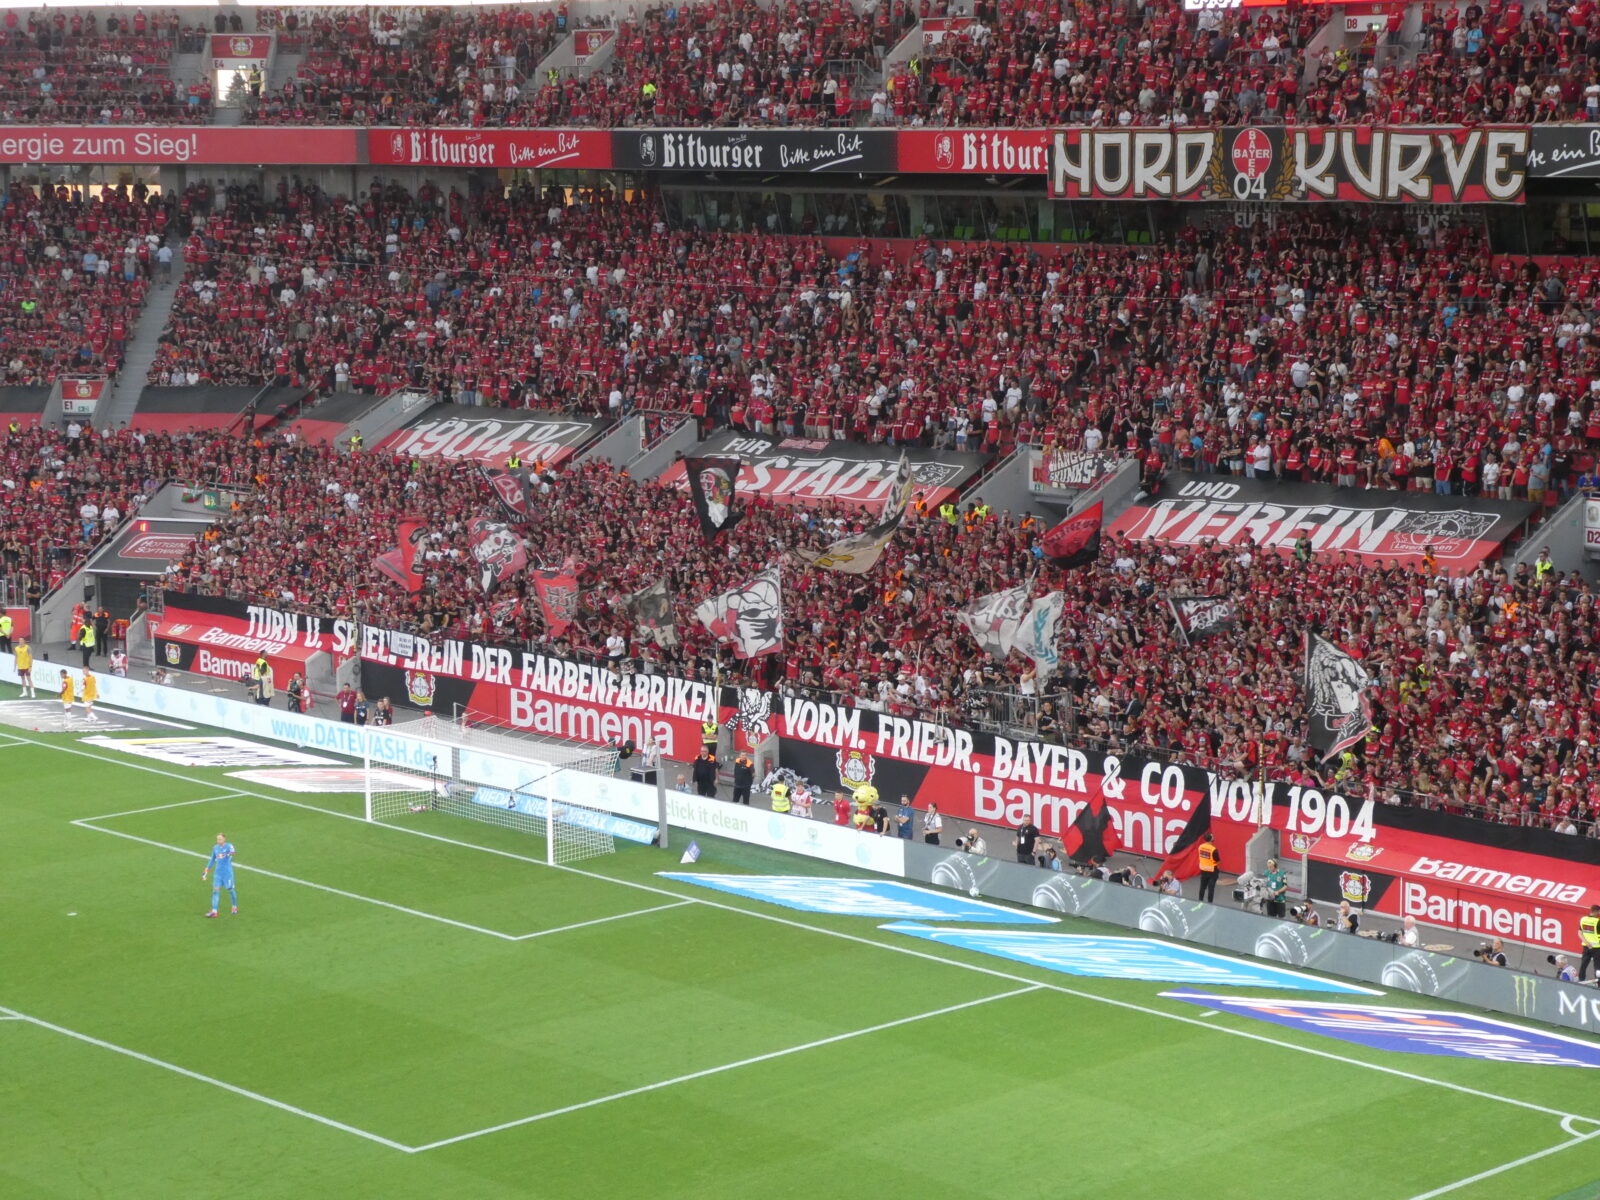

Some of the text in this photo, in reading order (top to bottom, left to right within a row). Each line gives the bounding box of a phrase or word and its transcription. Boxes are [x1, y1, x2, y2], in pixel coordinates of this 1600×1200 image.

[1346, 19, 1358, 30] D8
[213, 58, 225, 69] E4
[72, 137, 126, 156] zum
[134, 132, 198, 161] Sieg!
[410, 131, 496, 165] Bitburger
[509, 132, 581, 165] Bitte ein Bit
[662, 132, 764, 169] Bitburger
[780, 143, 811, 168] Bitte
[812, 144, 836, 159] ein
[961, 132, 1049, 171] Bitbur
[1233, 148, 1270, 159] BAYER
[1551, 143, 1586, 162] ein
[1051, 130, 1217, 197] NORD
[1292, 129, 1529, 199] KURVE
[1233, 172, 1267, 200] 04
[396, 419, 582, 462] 1904%
[721, 436, 773, 455] FÜR
[1177, 479, 1242, 500] UND
[1140, 500, 1410, 553] VEREIN
[198, 626, 288, 655] Barmenia
[246, 605, 299, 644] TURN
[305, 615, 323, 649] U.
[470, 643, 513, 686] DER
[519, 652, 723, 722] FARBENFABRIKEN
[783, 696, 867, 751] VORM.
[875, 713, 981, 774] FRIEDR.
[992, 735, 1089, 794] BAYER
[1100, 755, 1127, 800] &
[1140, 761, 1193, 812] CO.
[1206, 771, 1276, 825] VON
[1285, 785, 1377, 843] 1904
[510, 687, 674, 756] Barmenia
[711, 809, 750, 834] clean
[1408, 856, 1588, 904] Barmenia
[1404, 881, 1563, 945] Barmenia
